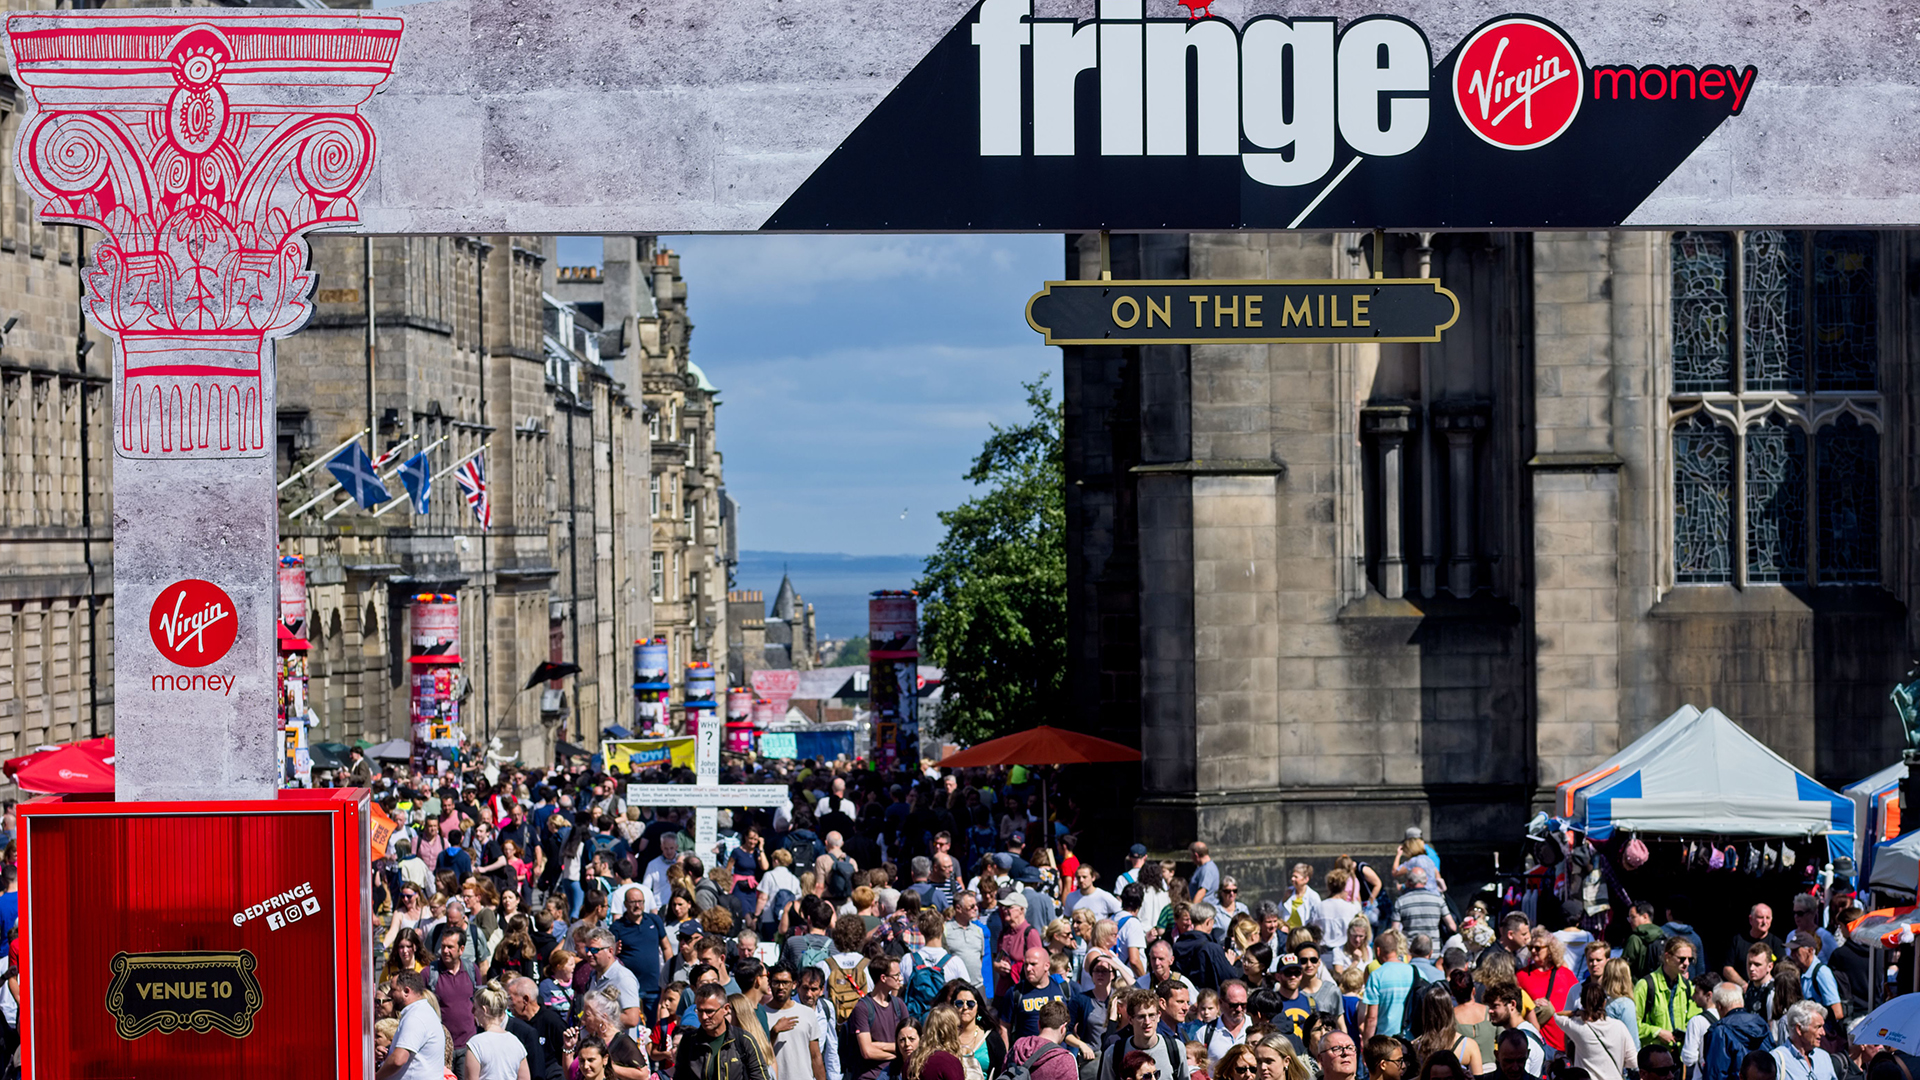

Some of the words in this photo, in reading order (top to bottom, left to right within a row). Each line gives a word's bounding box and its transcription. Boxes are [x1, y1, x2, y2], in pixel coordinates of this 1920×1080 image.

[972, 0, 1430, 187] fringe
[1468, 36, 1571, 129] Virgin
[1594, 68, 1753, 111] money
[1111, 295, 1171, 329] ON
[1189, 295, 1263, 328] THE
[1281, 294, 1370, 327] MILE
[159, 590, 229, 654] Virgin
[152, 674, 236, 697] money
[700, 721, 718, 729] WHY
[701, 767, 717, 775] 3:16
[373, 824, 385, 842] FREE
[379, 828, 389, 845] TOUR
[233, 881, 314, 928] @EDFRINGE
[135, 981, 208, 1000] VENUE
[211, 980, 233, 999] 10
